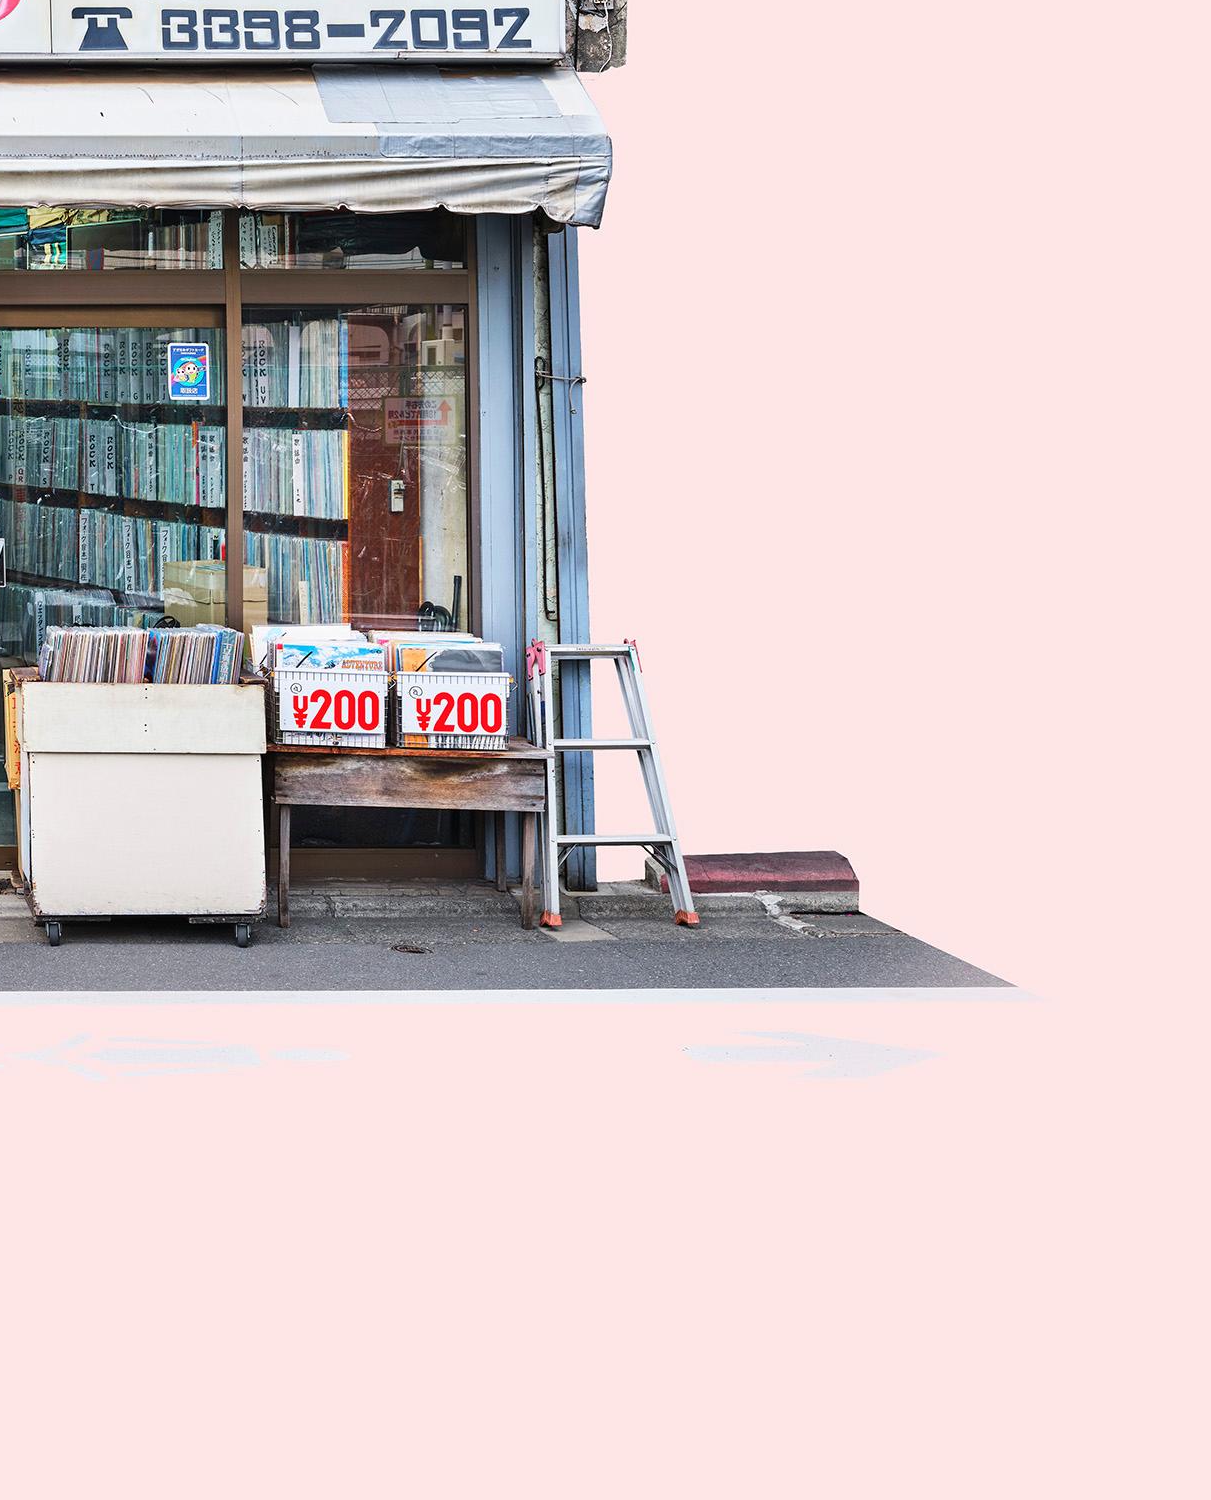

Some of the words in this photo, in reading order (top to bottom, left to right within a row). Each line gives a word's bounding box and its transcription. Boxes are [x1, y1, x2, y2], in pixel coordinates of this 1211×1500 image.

[161, 7, 532, 49] 3398-2092
[292, 689, 380, 731] ¥200
[416, 692, 502, 734] ¥200
